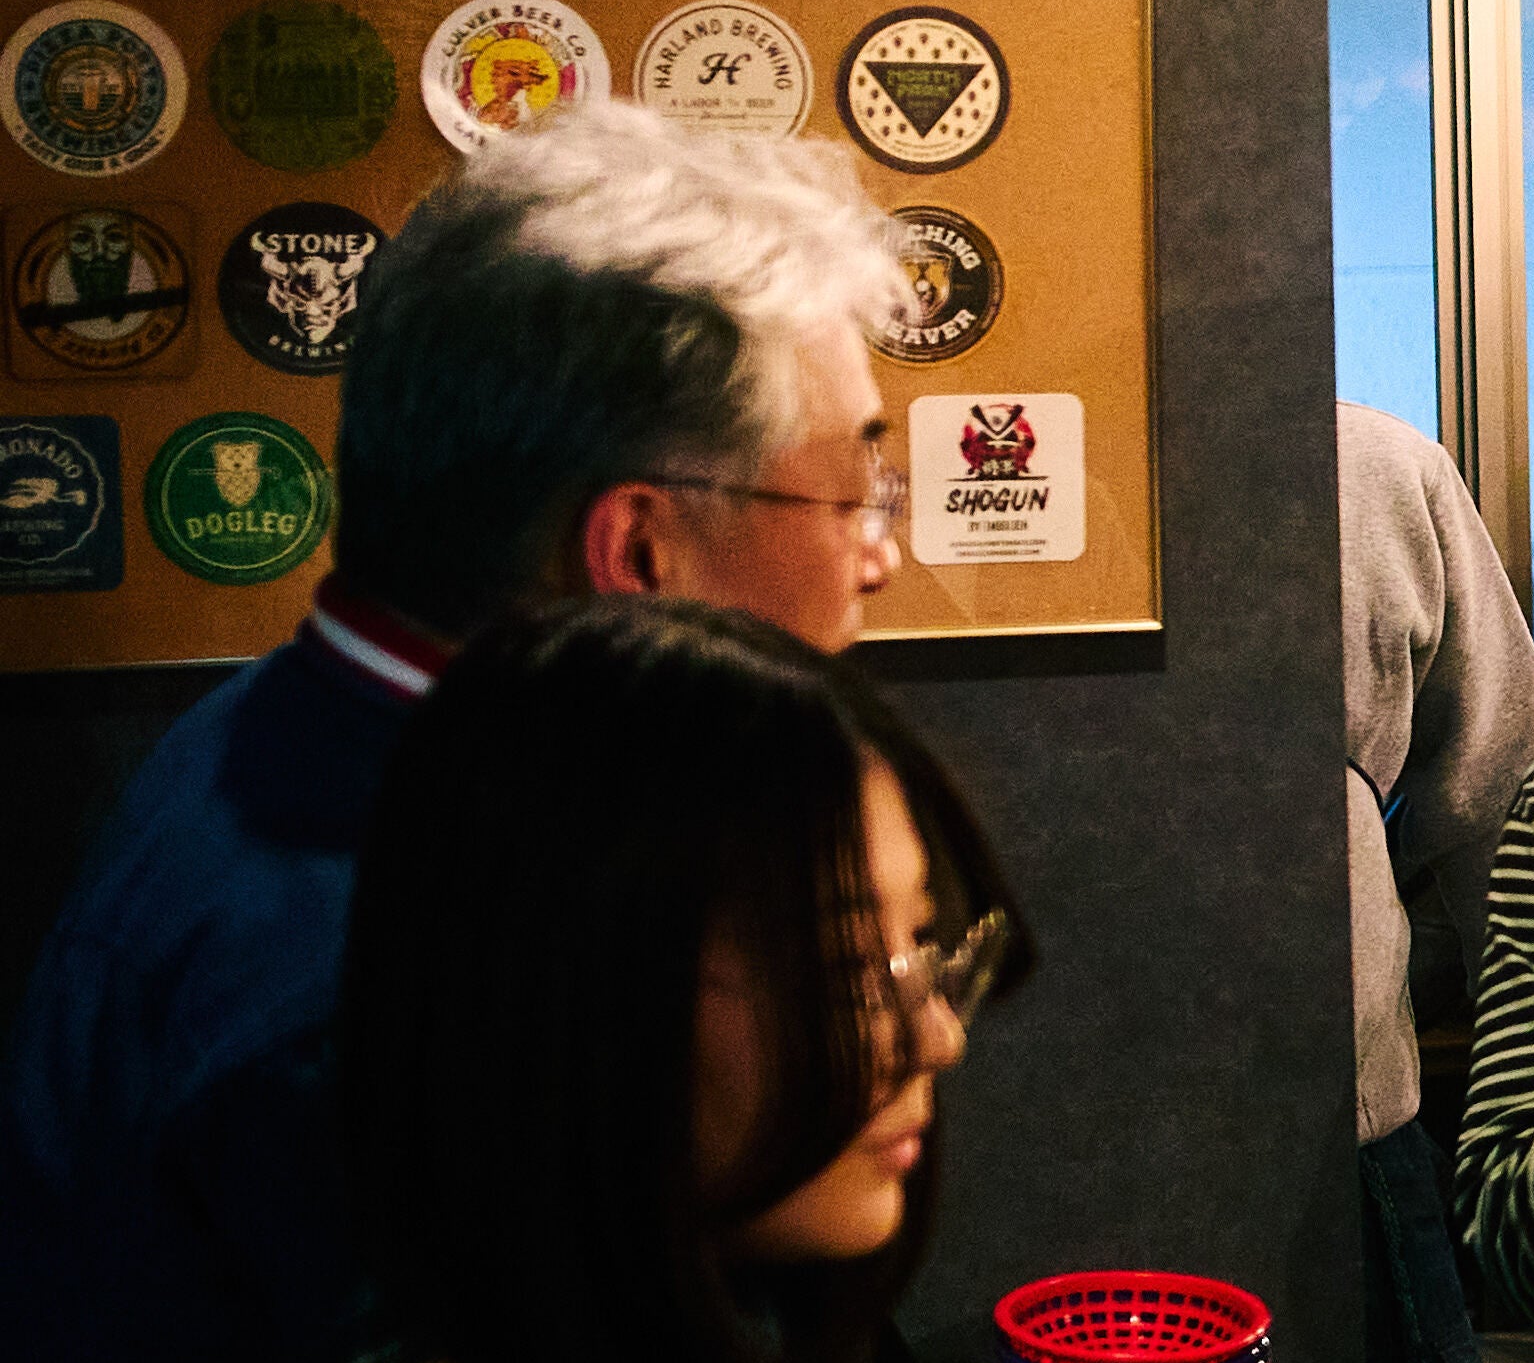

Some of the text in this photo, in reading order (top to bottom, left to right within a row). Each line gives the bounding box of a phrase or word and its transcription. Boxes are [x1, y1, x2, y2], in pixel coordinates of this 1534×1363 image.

[442, 7, 501, 58] CULVER
[512, 4, 563, 29] BEER
[654, 19, 793, 90] HARLAND BREWING
[265, 233, 360, 255] STONE
[887, 308, 976, 345] EAVER
[186, 510, 297, 540] DOGLEG
